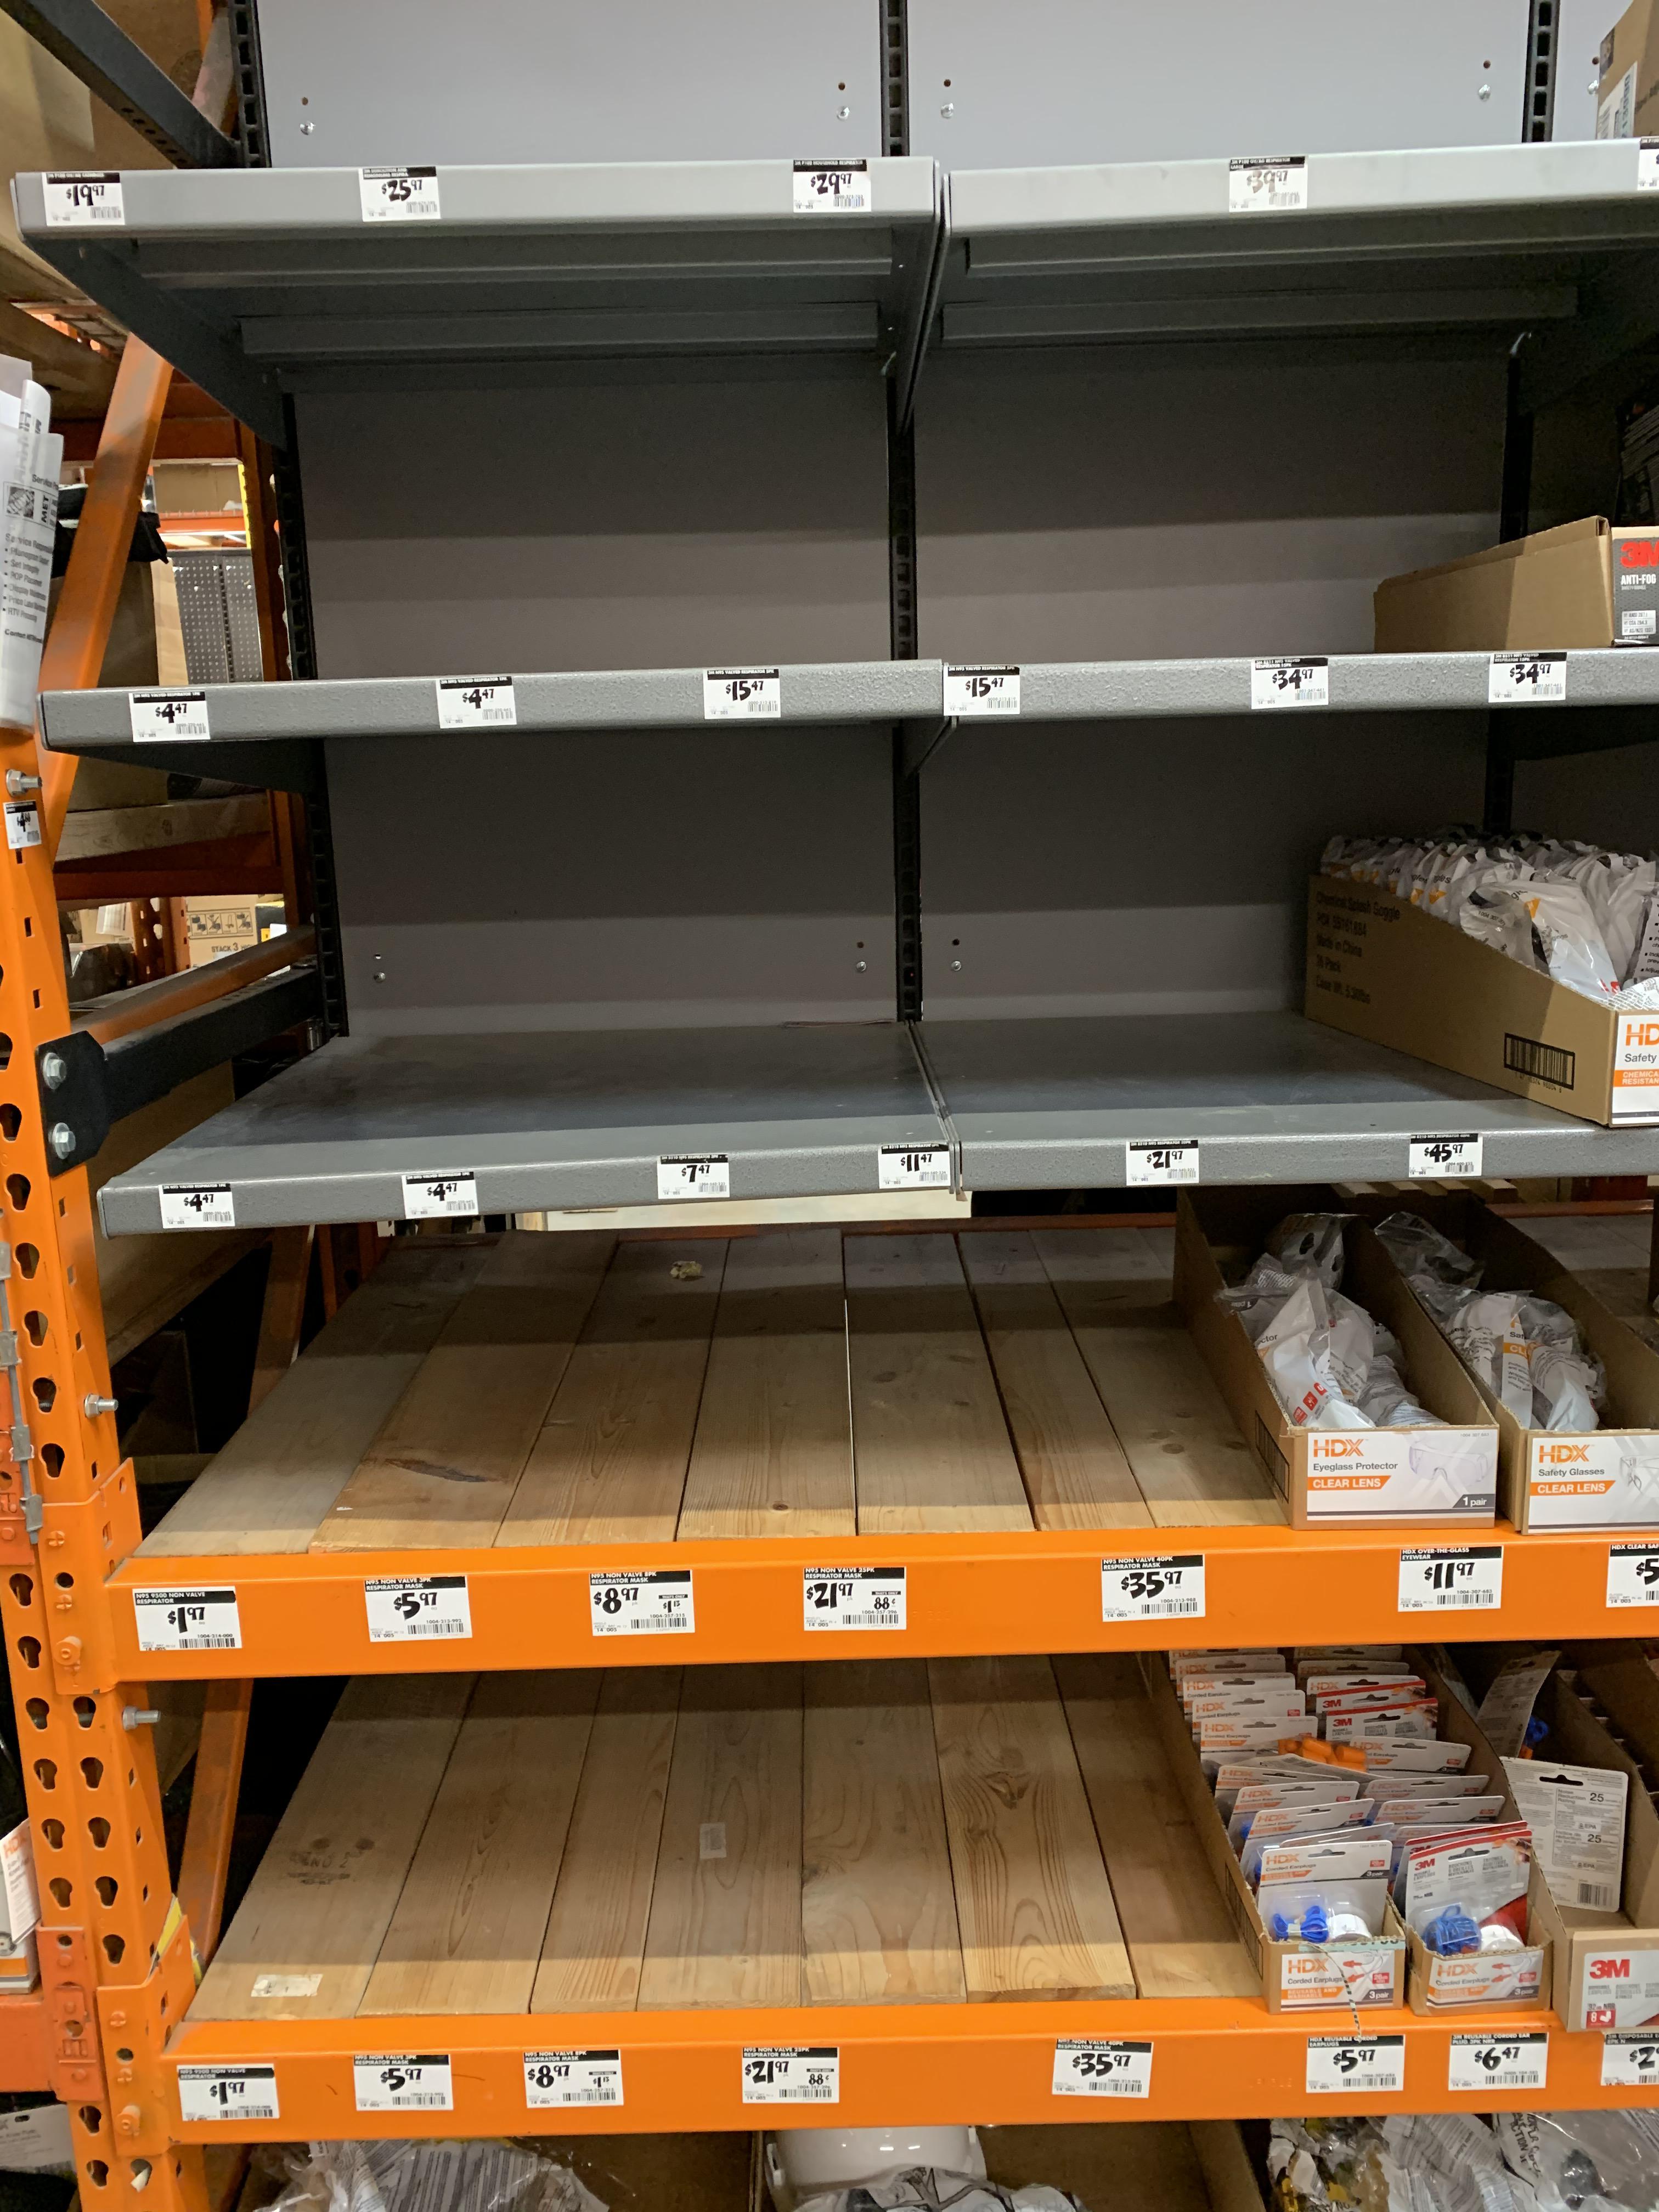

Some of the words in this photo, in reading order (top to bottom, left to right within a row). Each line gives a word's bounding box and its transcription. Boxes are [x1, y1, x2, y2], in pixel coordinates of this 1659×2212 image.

[1621, 539, 1659, 568] 3M
[1621, 574, 1656, 585] ANTI-FOG
[233, 942, 239, 951] 3
[1624, 1053, 1657, 1063] Safety
[1313, 1439, 1364, 1457] HDX
[1539, 1444, 1589, 1463] HDX
[1313, 1464, 1353, 1472] Eyeglass
[1313, 1479, 1349, 1488] CLEAR
[1353, 1478, 1381, 1487] LENS
[1537, 1484, 1574, 1493] CLEAR
[1577, 1483, 1606, 1492] LENS
[1463, 1497, 1468, 1506] 1
[1470, 1498, 1486, 1507] pair
[1590, 1793, 1604, 1802] 25
[1587, 1834, 1601, 1843] 25
[1266, 1854, 1299, 1865] HDX
[1415, 1858, 1435, 1870] 3M
[1288, 1959, 1329, 1974] HDX
[1437, 1963, 1479, 1976] HDX
[1589, 1959, 1630, 1979] 3M
[1376, 1991, 1389, 2000] pair
[1591, 2012, 1597, 2022] 8
